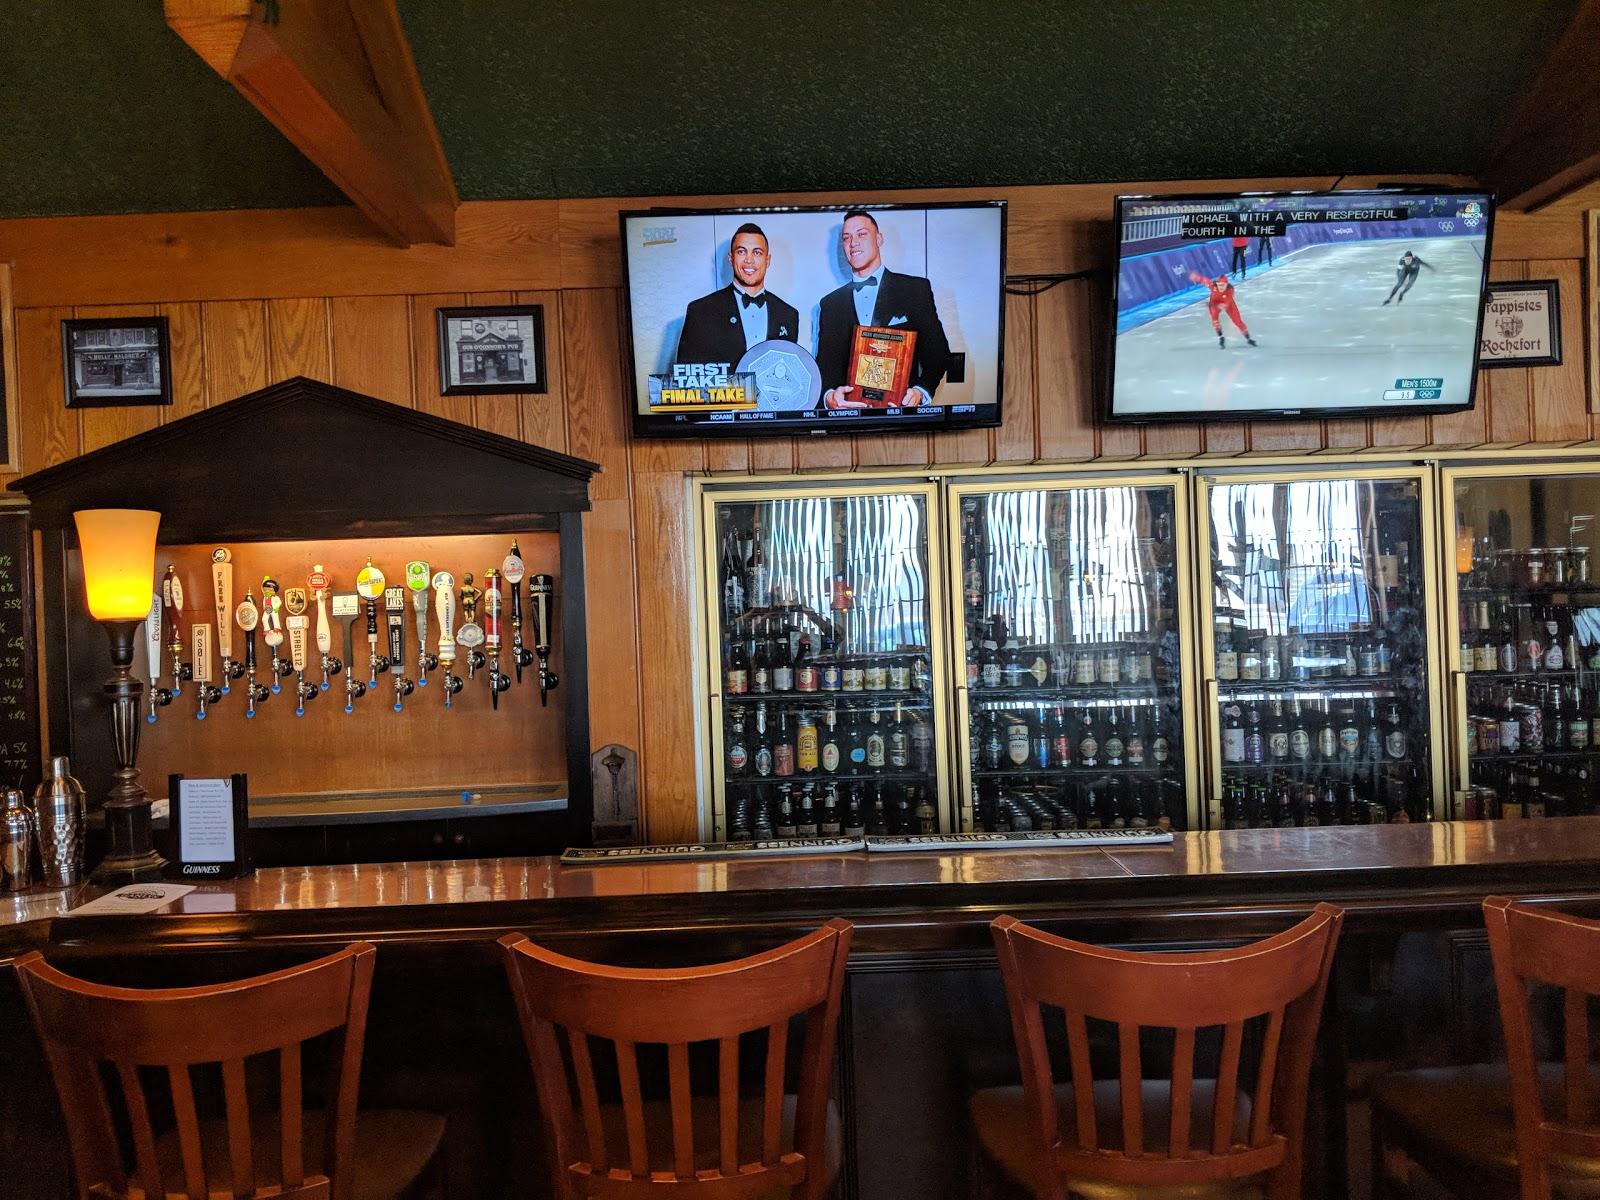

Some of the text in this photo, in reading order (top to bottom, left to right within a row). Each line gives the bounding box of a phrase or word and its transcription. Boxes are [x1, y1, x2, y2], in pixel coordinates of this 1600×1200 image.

[1182, 209, 1398, 223] MICHAEL WITH A VERY RESPECTFUL
[1181, 225, 1276, 237] FOURTH IN THE
[1486, 299, 1542, 316] rappistes
[1480, 337, 1541, 356] Rochefort
[673, 363, 731, 376] FIRST
[673, 375, 728, 388] TAKE
[661, 387, 745, 404] FINAL TAKE
[828, 409, 859, 417] OLYMPICS
[887, 407, 900, 415] MLB
[917, 406, 943, 414] SOCCER
[952, 405, 976, 413] ESPN
[385, 588, 404, 598] GREAT
[386, 597, 404, 607] LAKES
[294, 630, 302, 657] STABLE
[756, 838, 853, 849] GUINNESS
[607, 845, 706, 856] GUINNESS
[182, 864, 221, 874] GUINNESS
